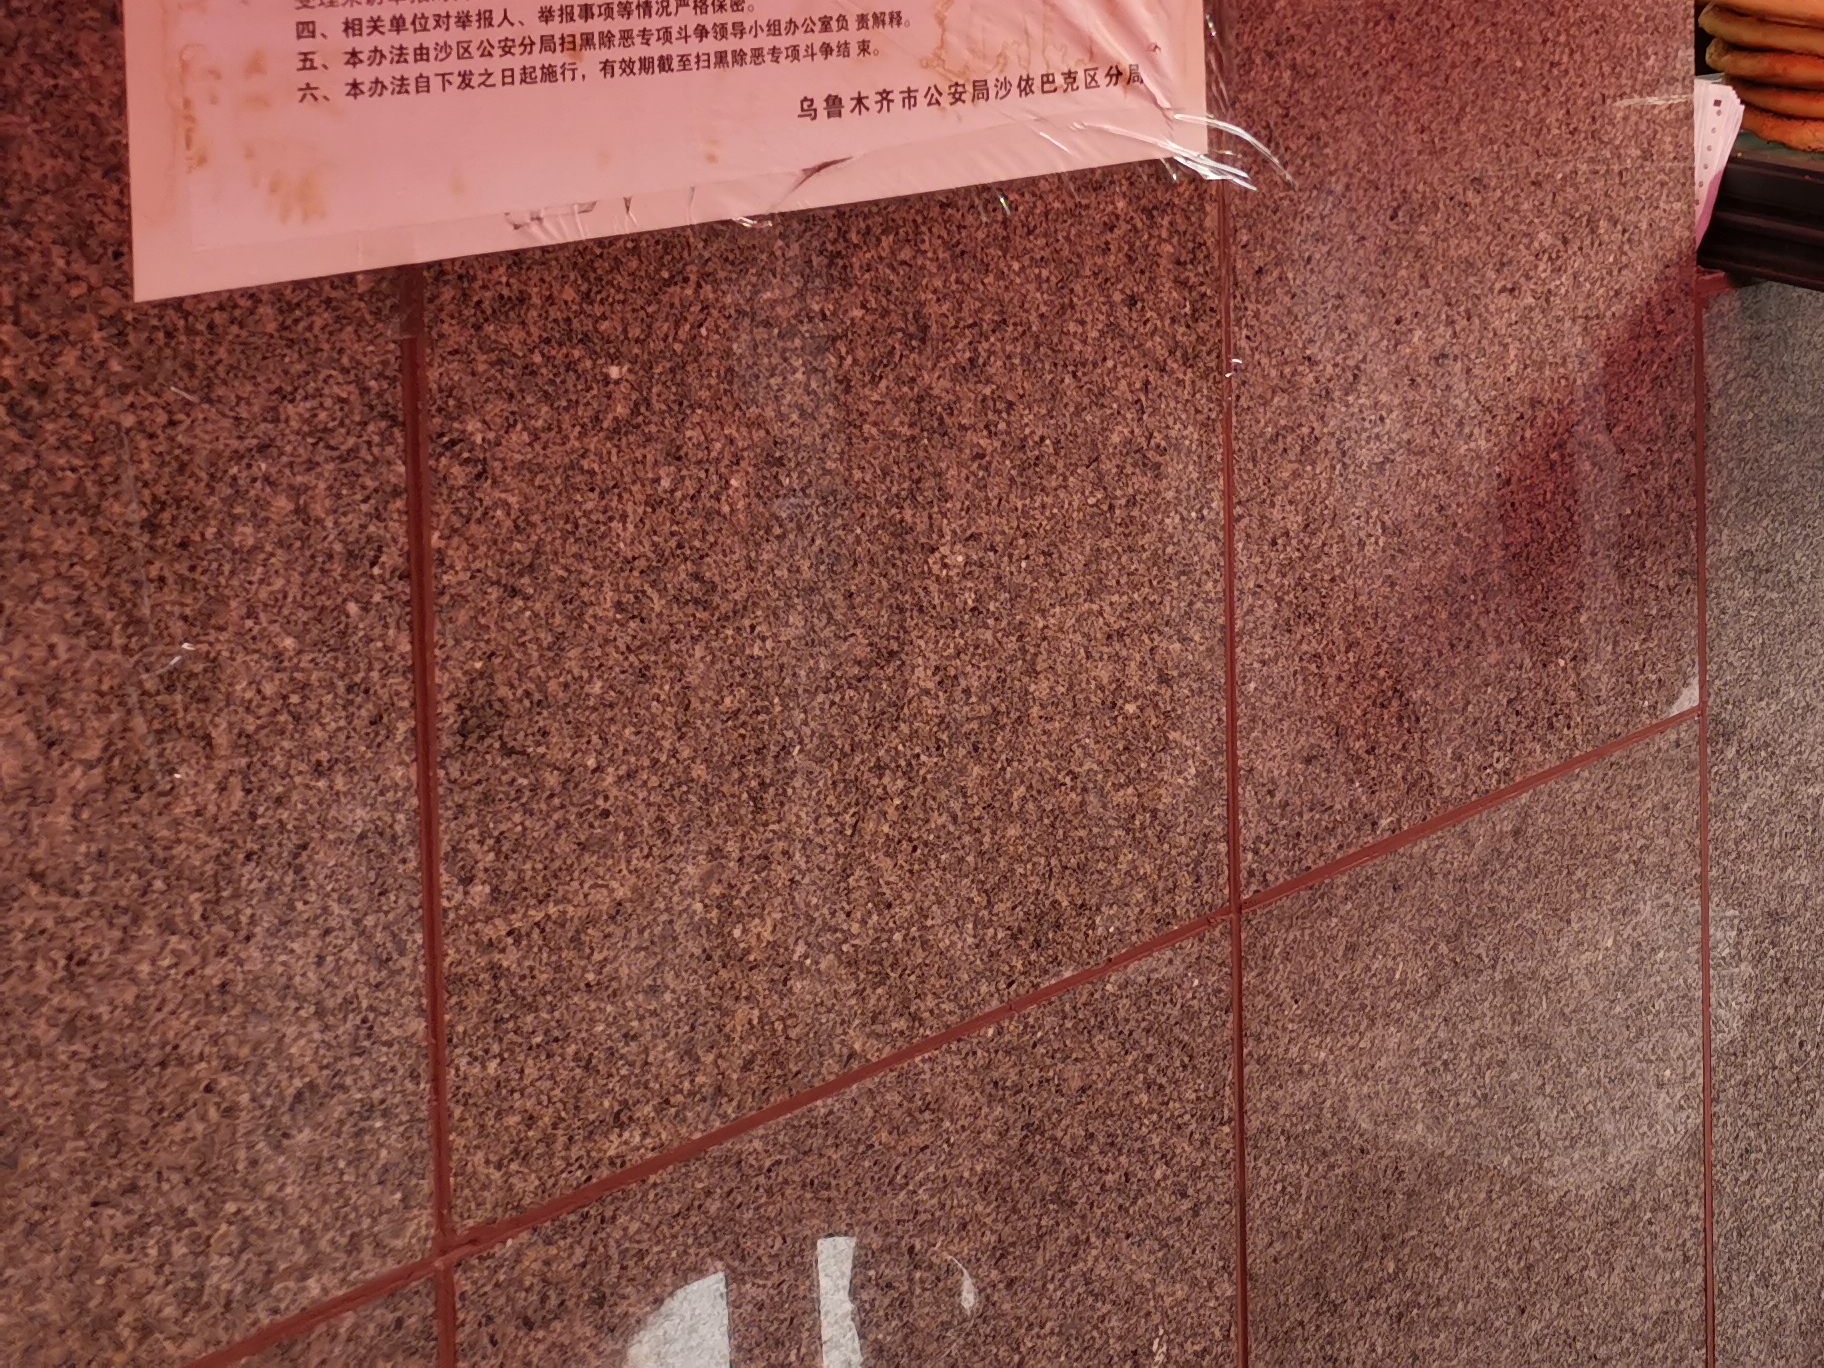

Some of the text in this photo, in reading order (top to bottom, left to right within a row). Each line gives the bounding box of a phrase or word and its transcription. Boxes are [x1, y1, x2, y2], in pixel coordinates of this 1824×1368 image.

[797, 63, 1145, 121] 乌鲁木齐市公安局沙依巴克区分局
